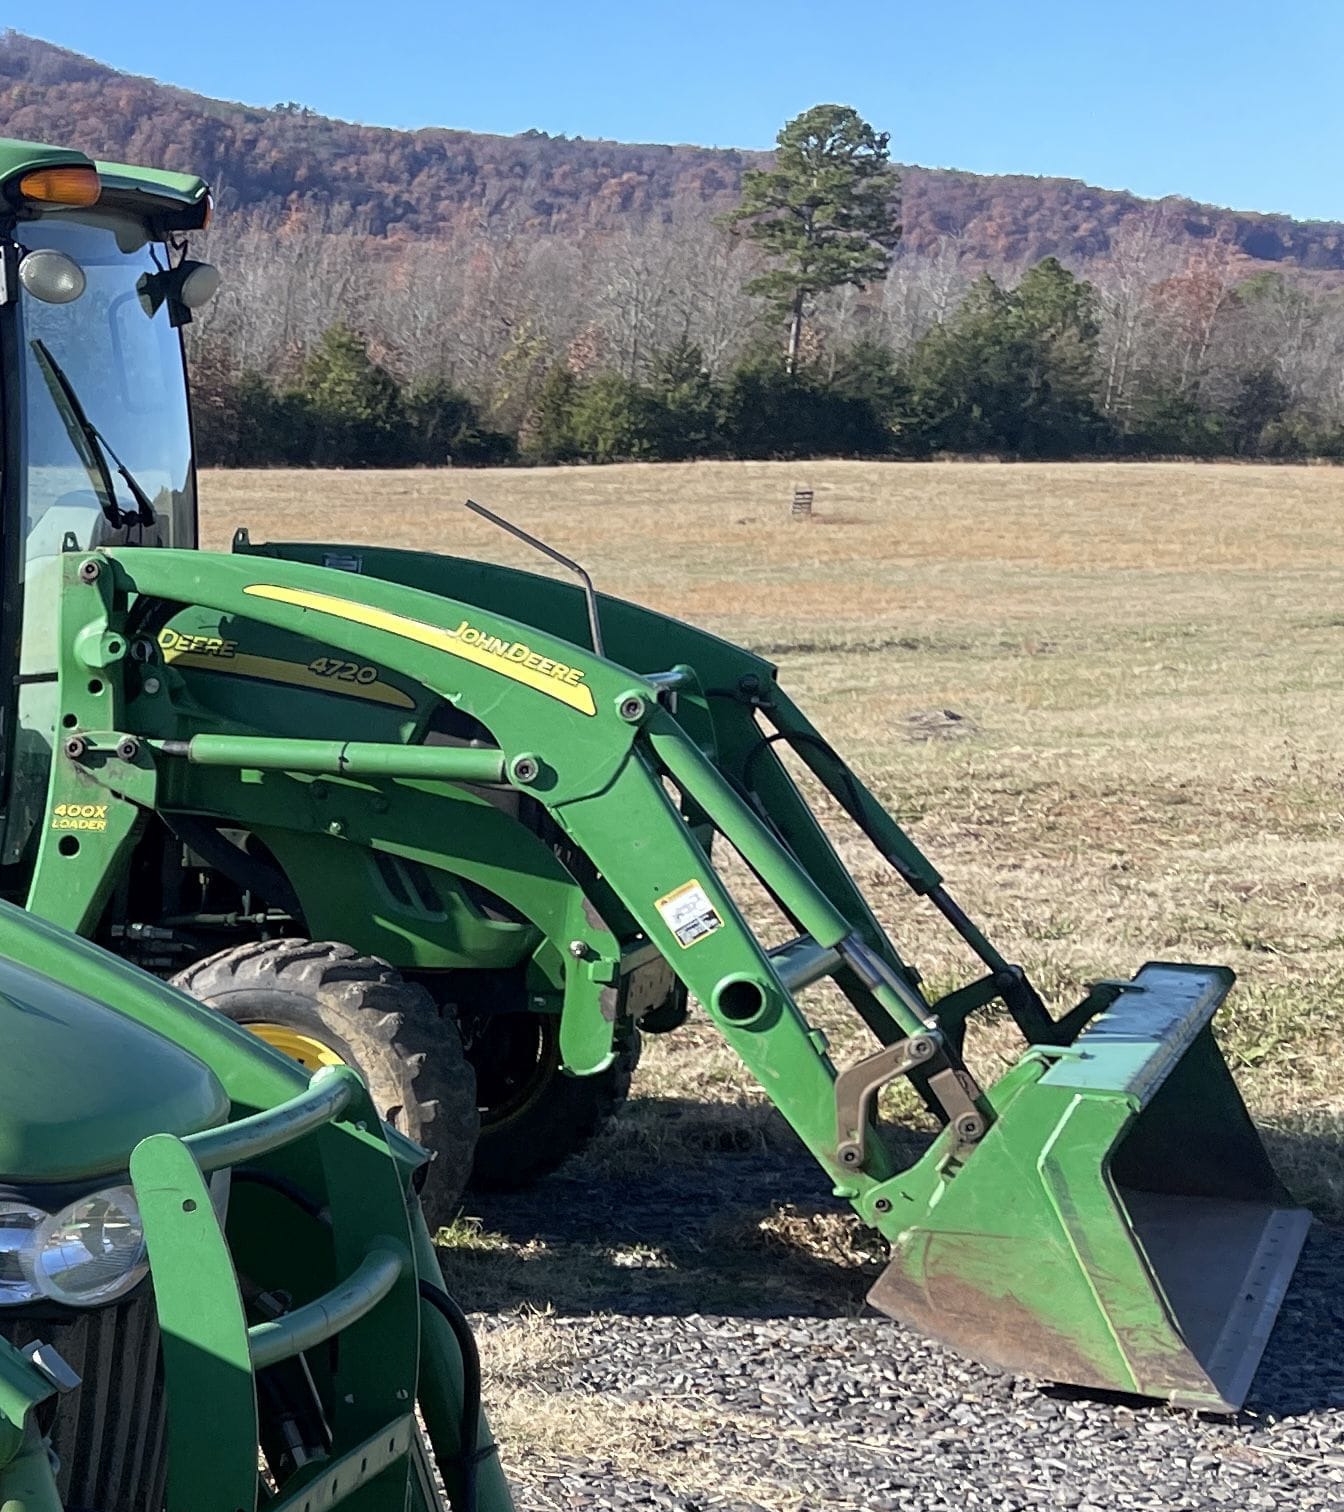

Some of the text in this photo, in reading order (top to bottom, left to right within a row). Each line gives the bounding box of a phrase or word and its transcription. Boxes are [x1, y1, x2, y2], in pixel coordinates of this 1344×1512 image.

[158, 628, 239, 657] DEERE
[308, 657, 378, 684] 4720
[54, 804, 108, 819] 400X
[52, 819, 107, 831] LOADER
